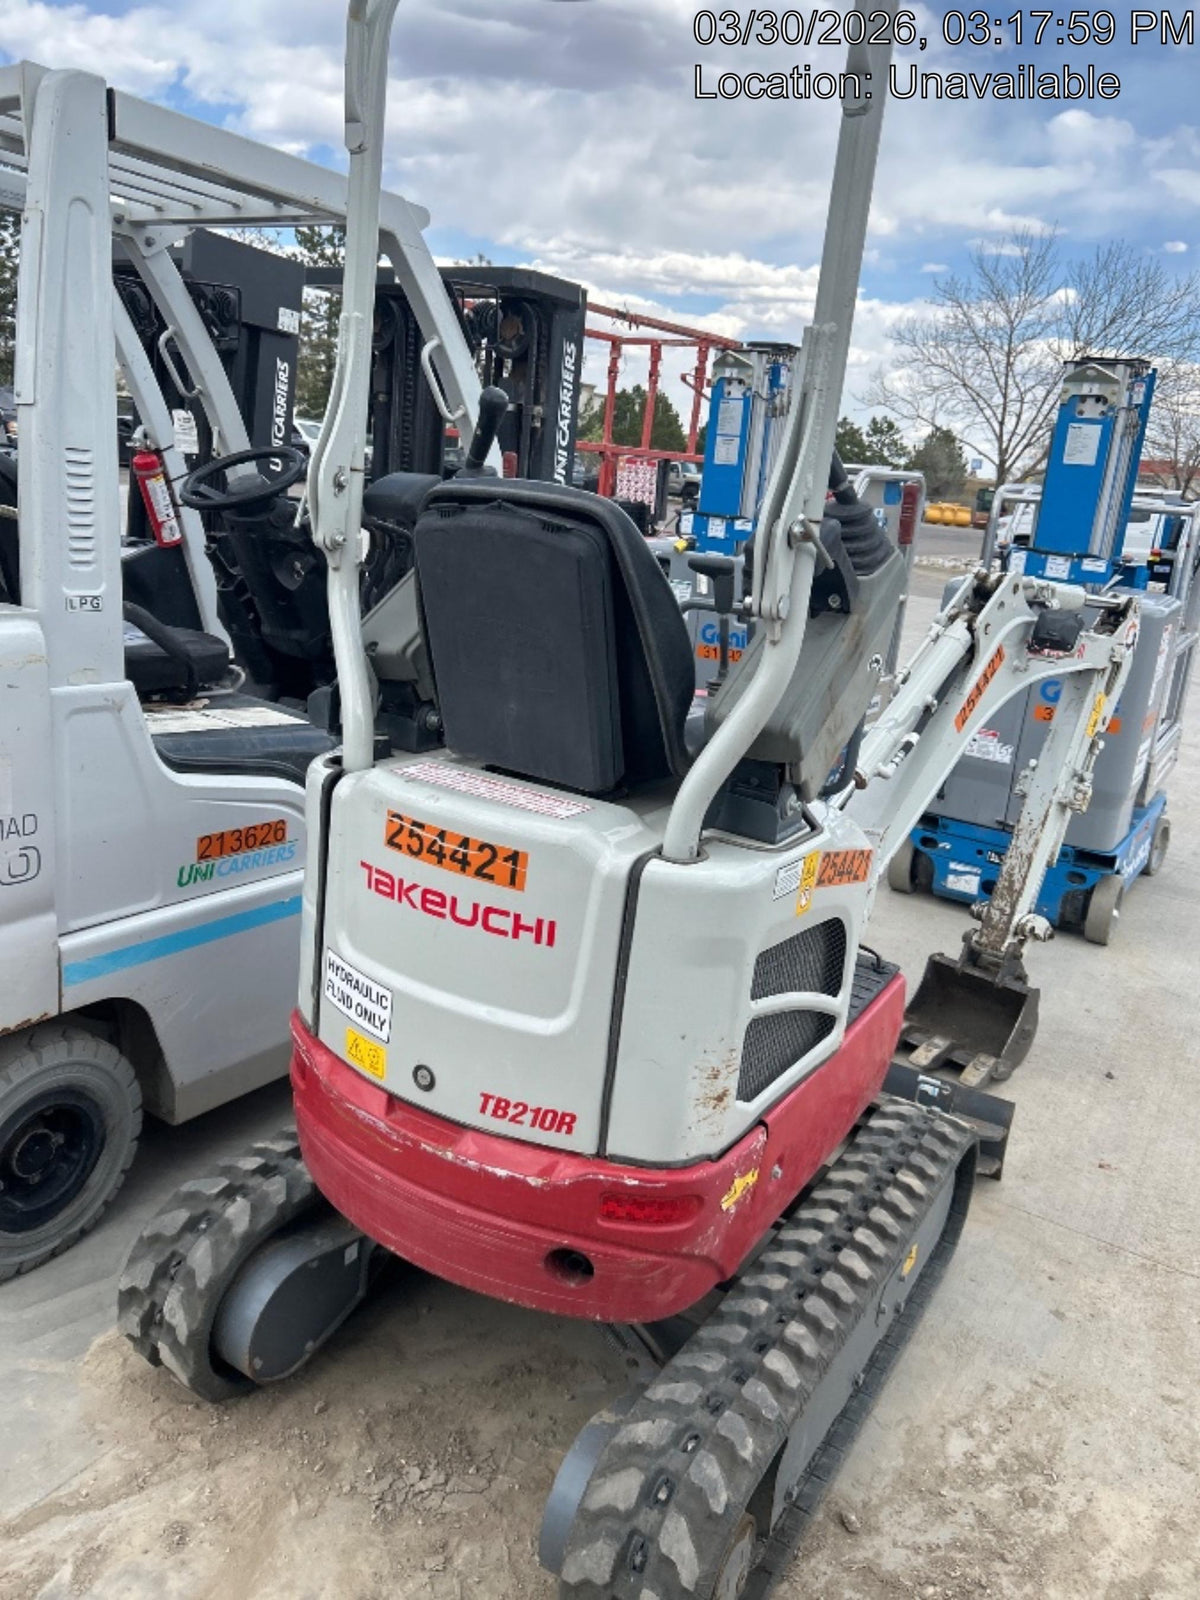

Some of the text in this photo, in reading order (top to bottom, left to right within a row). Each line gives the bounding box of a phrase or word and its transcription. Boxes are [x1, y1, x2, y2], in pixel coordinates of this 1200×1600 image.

[199, 819, 287, 860] 213626
[386, 812, 521, 887] 254421
[327, 956, 389, 1011] HYDRAULIC
[354, 1001, 387, 1032] ONLY
[479, 1091, 578, 1135] TB210R
